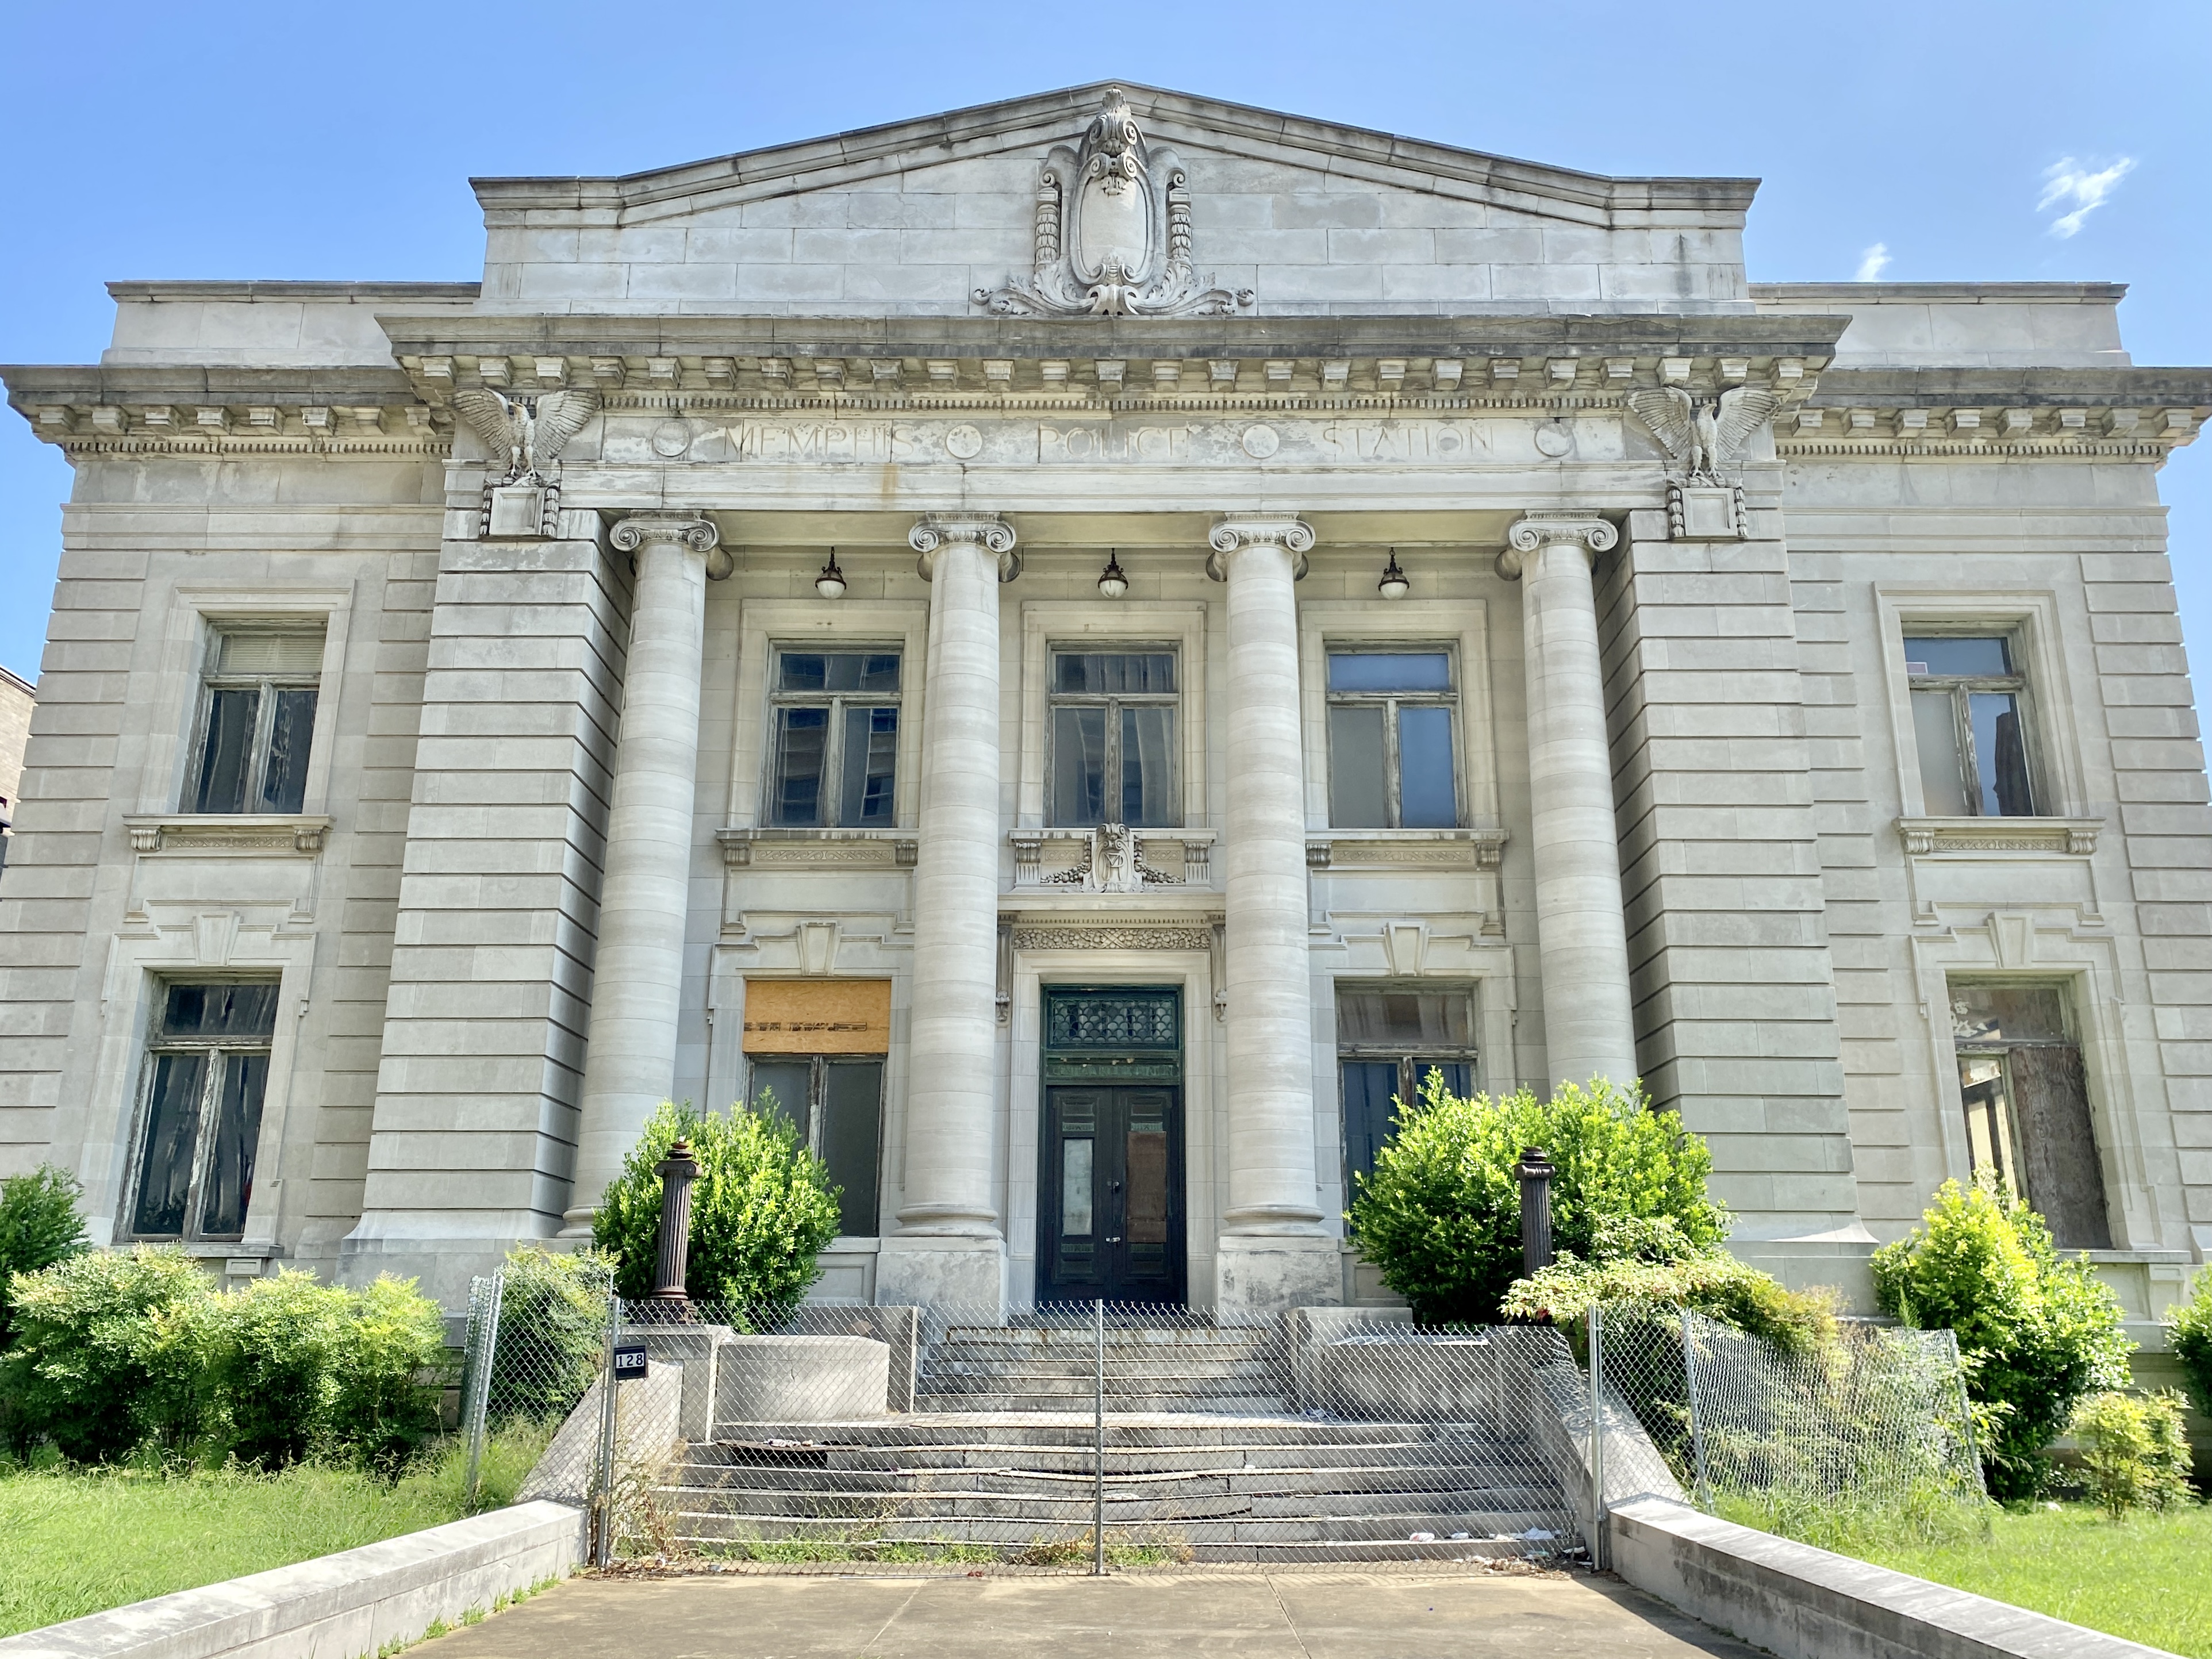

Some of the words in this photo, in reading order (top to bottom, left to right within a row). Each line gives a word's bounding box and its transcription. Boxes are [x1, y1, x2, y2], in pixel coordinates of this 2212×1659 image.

[724, 425, 914, 457] MEMPHIS
[1038, 427, 1189, 458] POLICE
[1323, 427, 1494, 456] STATION
[619, 1354, 643, 1367] 128
